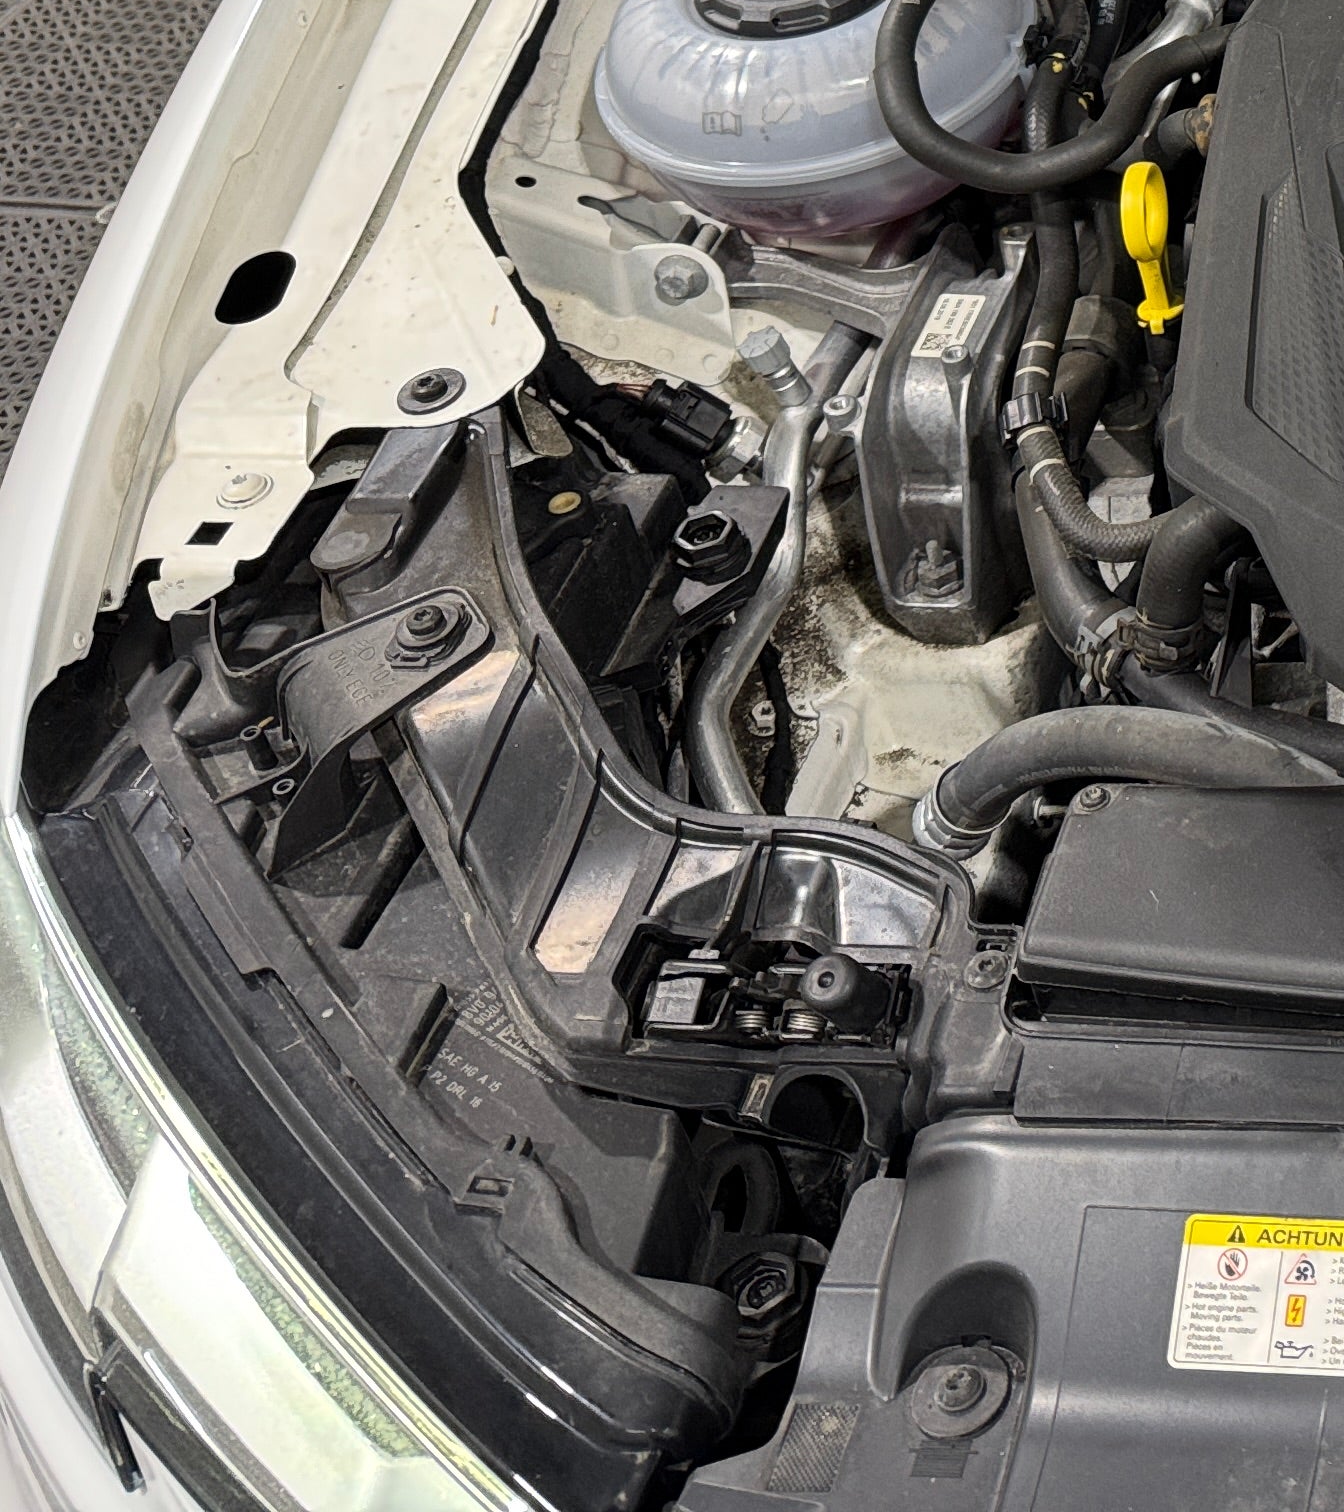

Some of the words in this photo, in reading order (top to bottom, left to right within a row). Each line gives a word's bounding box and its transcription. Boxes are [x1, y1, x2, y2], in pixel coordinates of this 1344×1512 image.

[328, 649, 353, 678] ONLY
[345, 678, 375, 705] ECE
[438, 1048, 462, 1067] SAE
[461, 1064, 478, 1077] HG
[430, 1071, 448, 1085] P2
[446, 1081, 467, 1099] DRL
